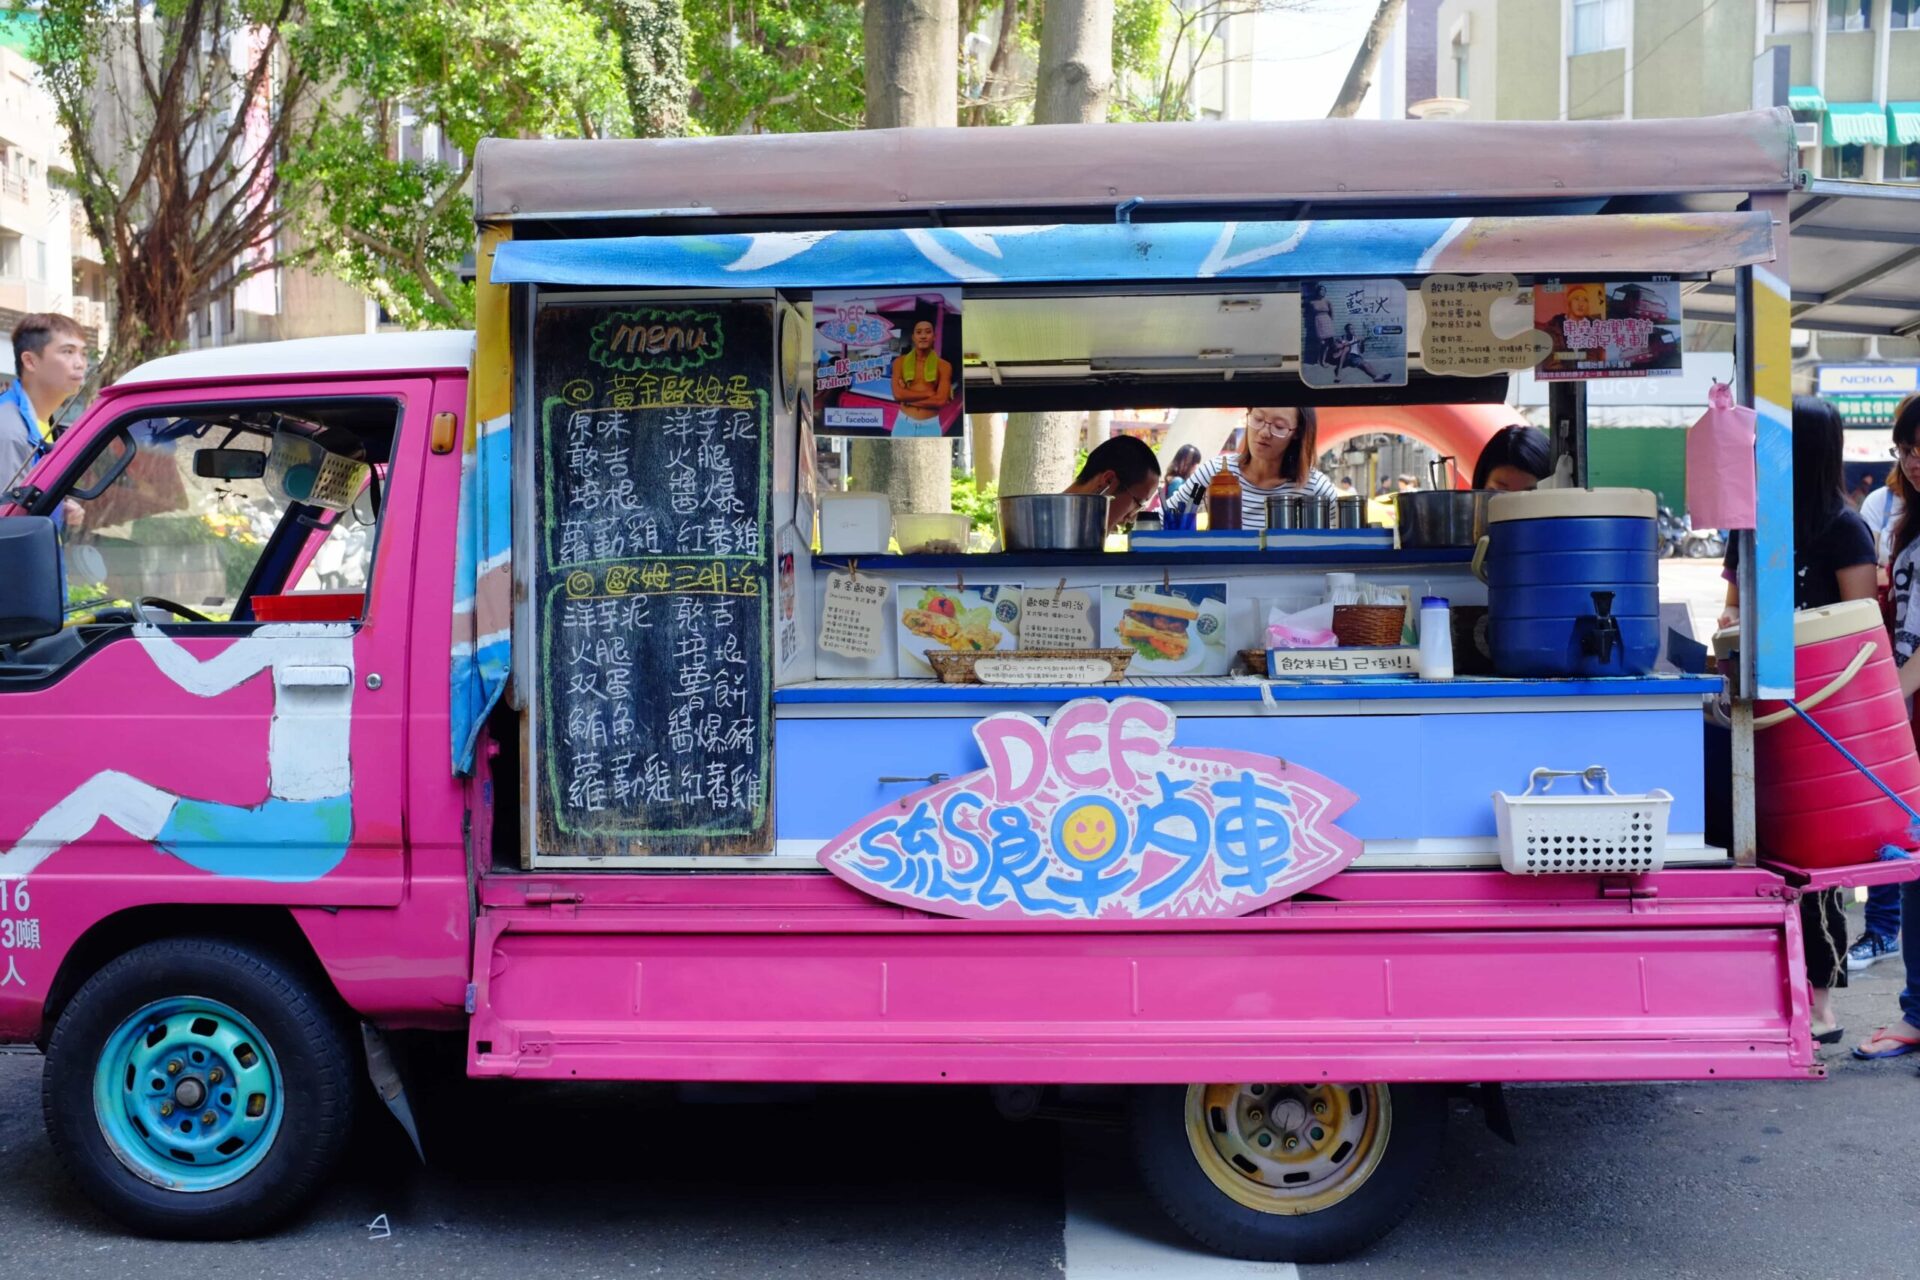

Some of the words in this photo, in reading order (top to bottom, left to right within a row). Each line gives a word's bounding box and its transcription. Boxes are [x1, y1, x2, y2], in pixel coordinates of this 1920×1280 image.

[837, 305, 865, 322] DEF
[610, 323, 708, 355] menu
[606, 373, 755, 411] 黃金歐姆蛋
[817, 377, 852, 390] Follow
[1590, 379, 1659, 399] Lucy's
[1840, 376, 1895, 384] NOKIA
[568, 411, 631, 440] 原味
[662, 407, 757, 443] 洋芋泥
[845, 415, 879, 424] facebook
[665, 440, 735, 472] 火腿
[605, 561, 759, 594] 歐姆三明治
[563, 594, 653, 636] 洋芋泥
[1026, 597, 1084, 611] 歐姆三明治
[569, 636, 633, 667] 火腿
[564, 703, 641, 747] 鮪魚
[975, 701, 1169, 802] DEF
[1, 918, 41, 950] 3噸
[1, 955, 26, 987] 人
